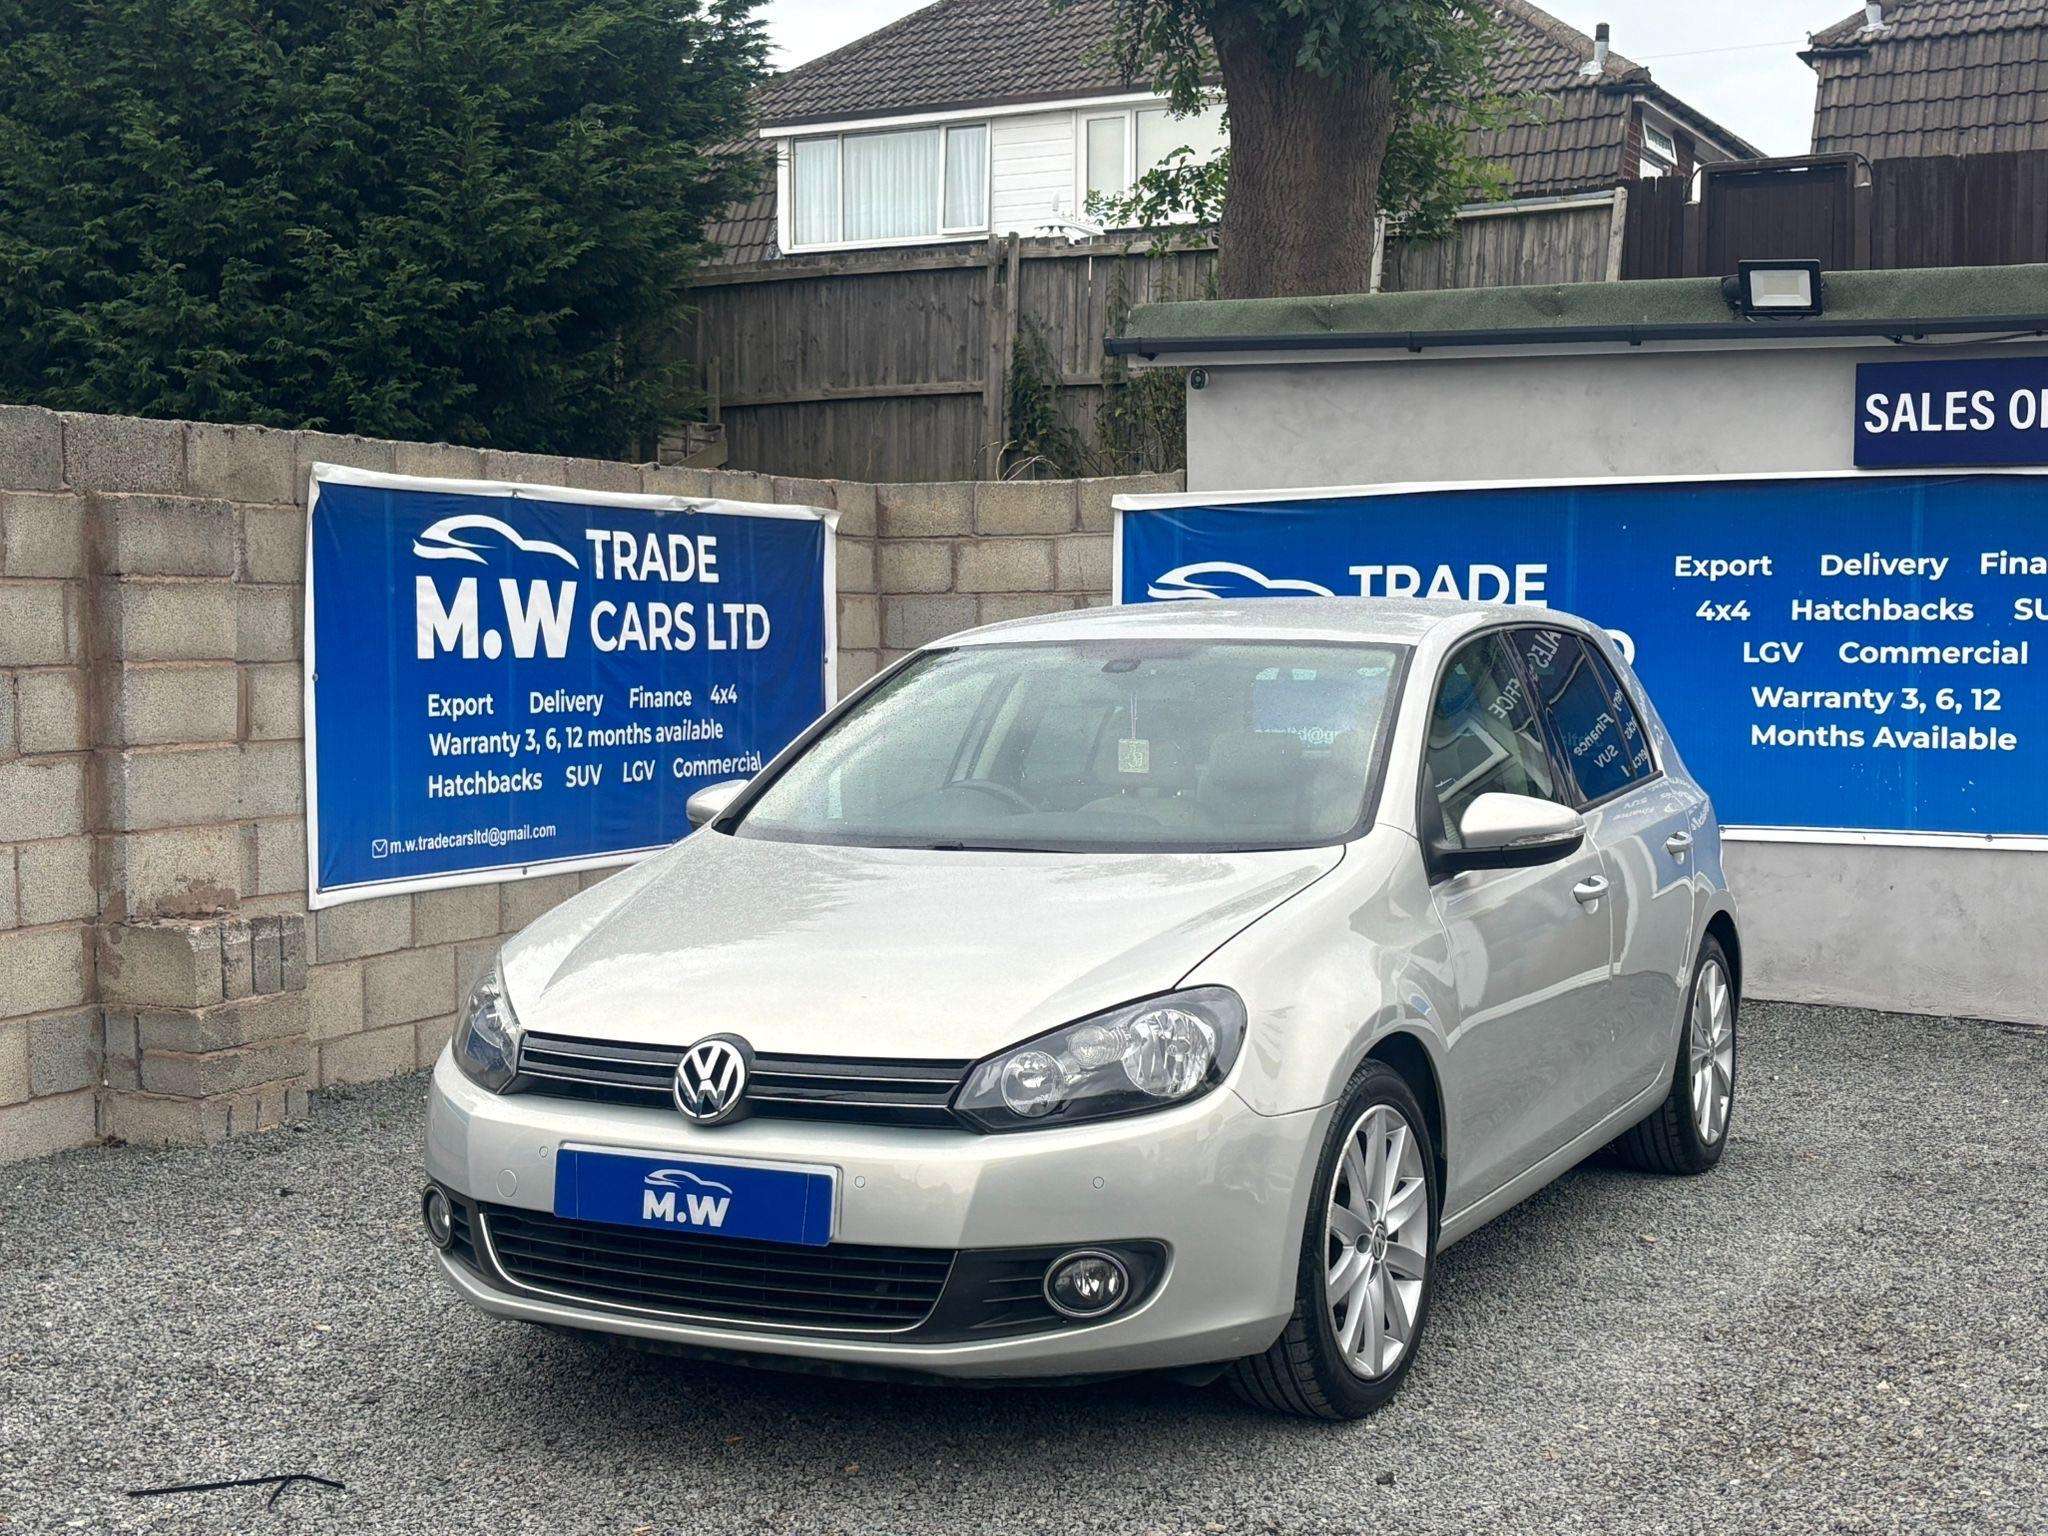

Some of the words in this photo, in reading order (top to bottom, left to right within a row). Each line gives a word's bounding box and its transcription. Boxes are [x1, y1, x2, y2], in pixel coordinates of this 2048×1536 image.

[1864, 389, 1995, 434] SALES
[586, 529, 720, 583] TRADE
[1675, 555, 1773, 582] Export
[1820, 551, 1949, 581] Delivery
[1348, 563, 1548, 609] TRADE
[415, 575, 578, 660] M.W
[590, 600, 697, 652] CARS
[707, 602, 771, 650] LTD
[1695, 599, 1751, 622] 4x4
[1791, 597, 1974, 621] Hatchbacks
[1743, 641, 1804, 663] LGV
[1838, 639, 2028, 665] Commercial
[428, 693, 494, 721] Export
[529, 688, 604, 717] Delivery
[629, 685, 692, 709] Finance
[710, 683, 738, 704] 4x4
[1751, 686, 1894, 715] Warranty
[1900, 687, 1927, 714] 3,
[1935, 687, 1963, 715] 6,
[1970, 688, 2003, 712] 12
[428, 731, 521, 758] Warranty
[525, 726, 542, 755] 3,
[545, 726, 562, 754] 6,
[565, 726, 584, 748] 12
[587, 724, 652, 747] months
[655, 718, 724, 743] available
[1751, 724, 1865, 748] Months
[1872, 724, 2018, 751] Available
[428, 767, 543, 799] Hatchbacks
[565, 763, 603, 788] SUV
[622, 759, 656, 783] LGV
[672, 750, 762, 777] Commercial
[389, 824, 556, 854] m.w.tradecarsltd@gmail.com
[642, 1189, 730, 1228] M.W
